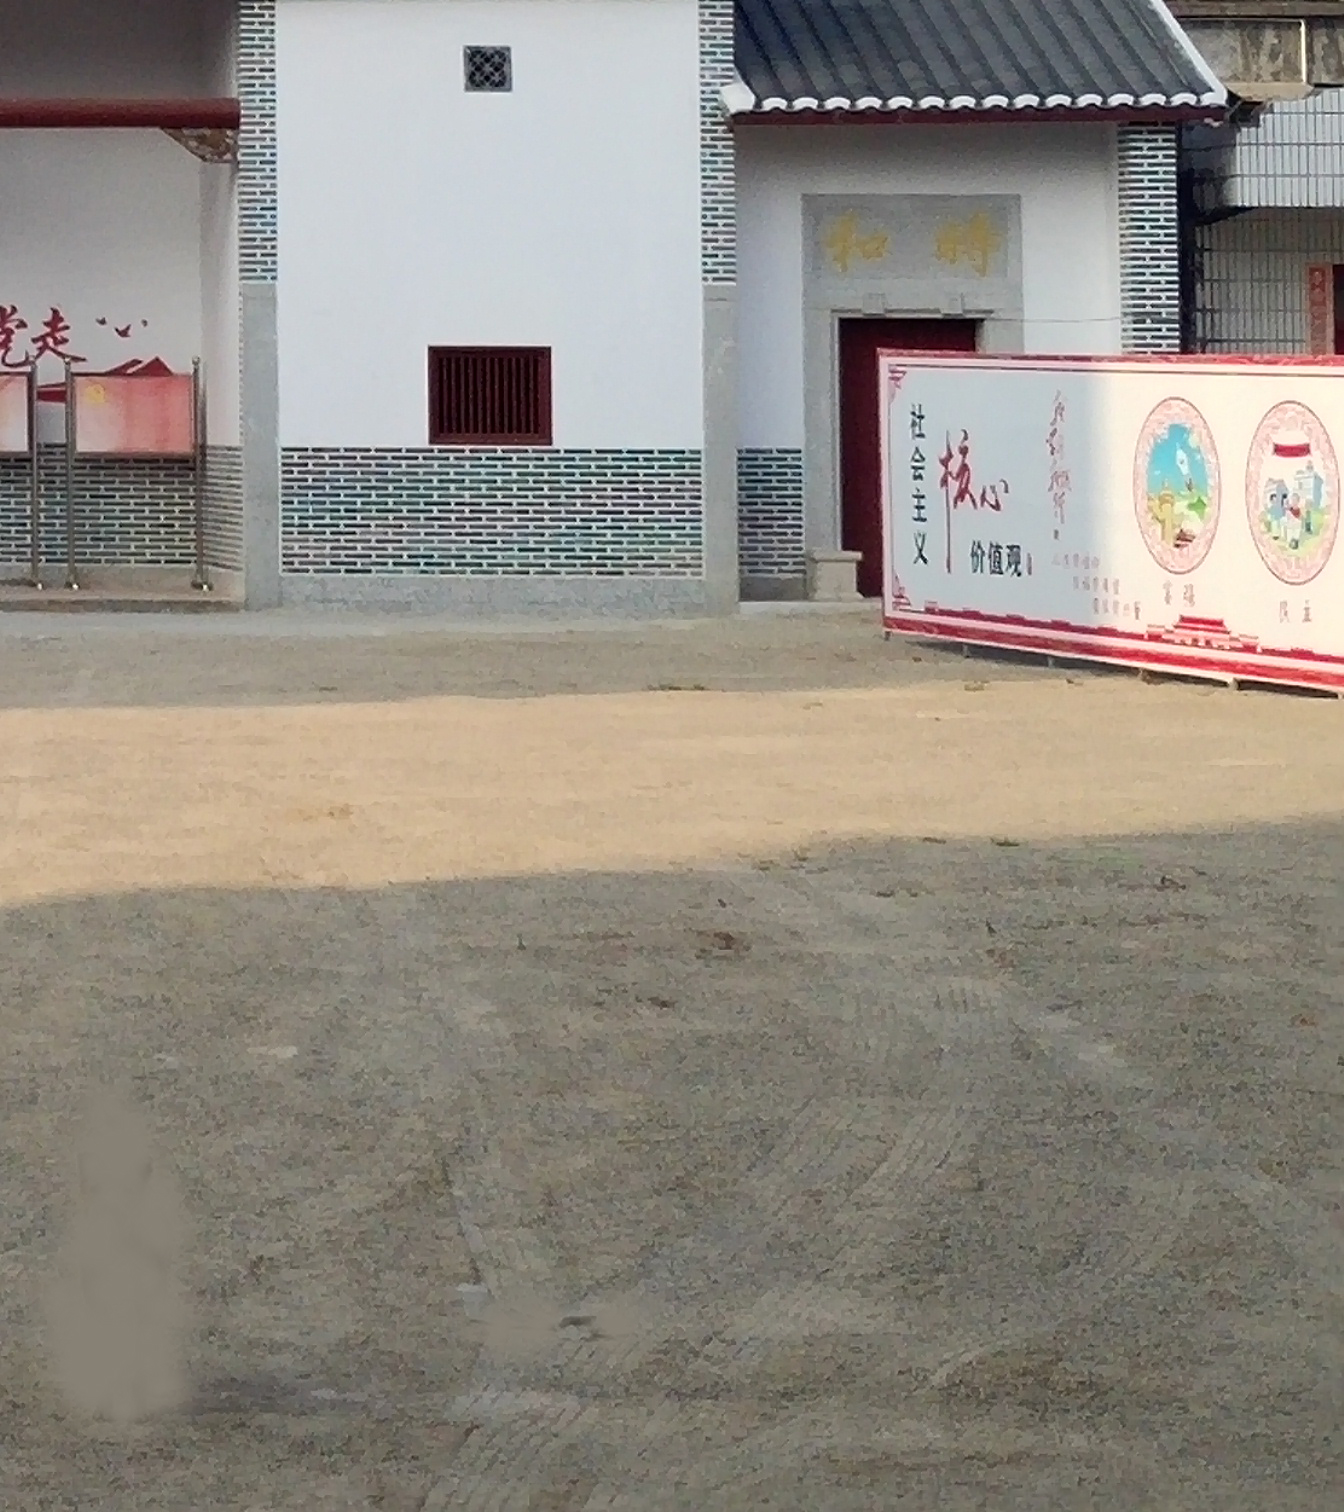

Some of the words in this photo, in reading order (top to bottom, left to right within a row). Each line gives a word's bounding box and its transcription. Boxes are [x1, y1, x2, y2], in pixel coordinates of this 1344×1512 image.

[910, 403, 928, 565] 社会主义
[938, 428, 1009, 574] 核心
[970, 539, 1022, 578] 价值观
